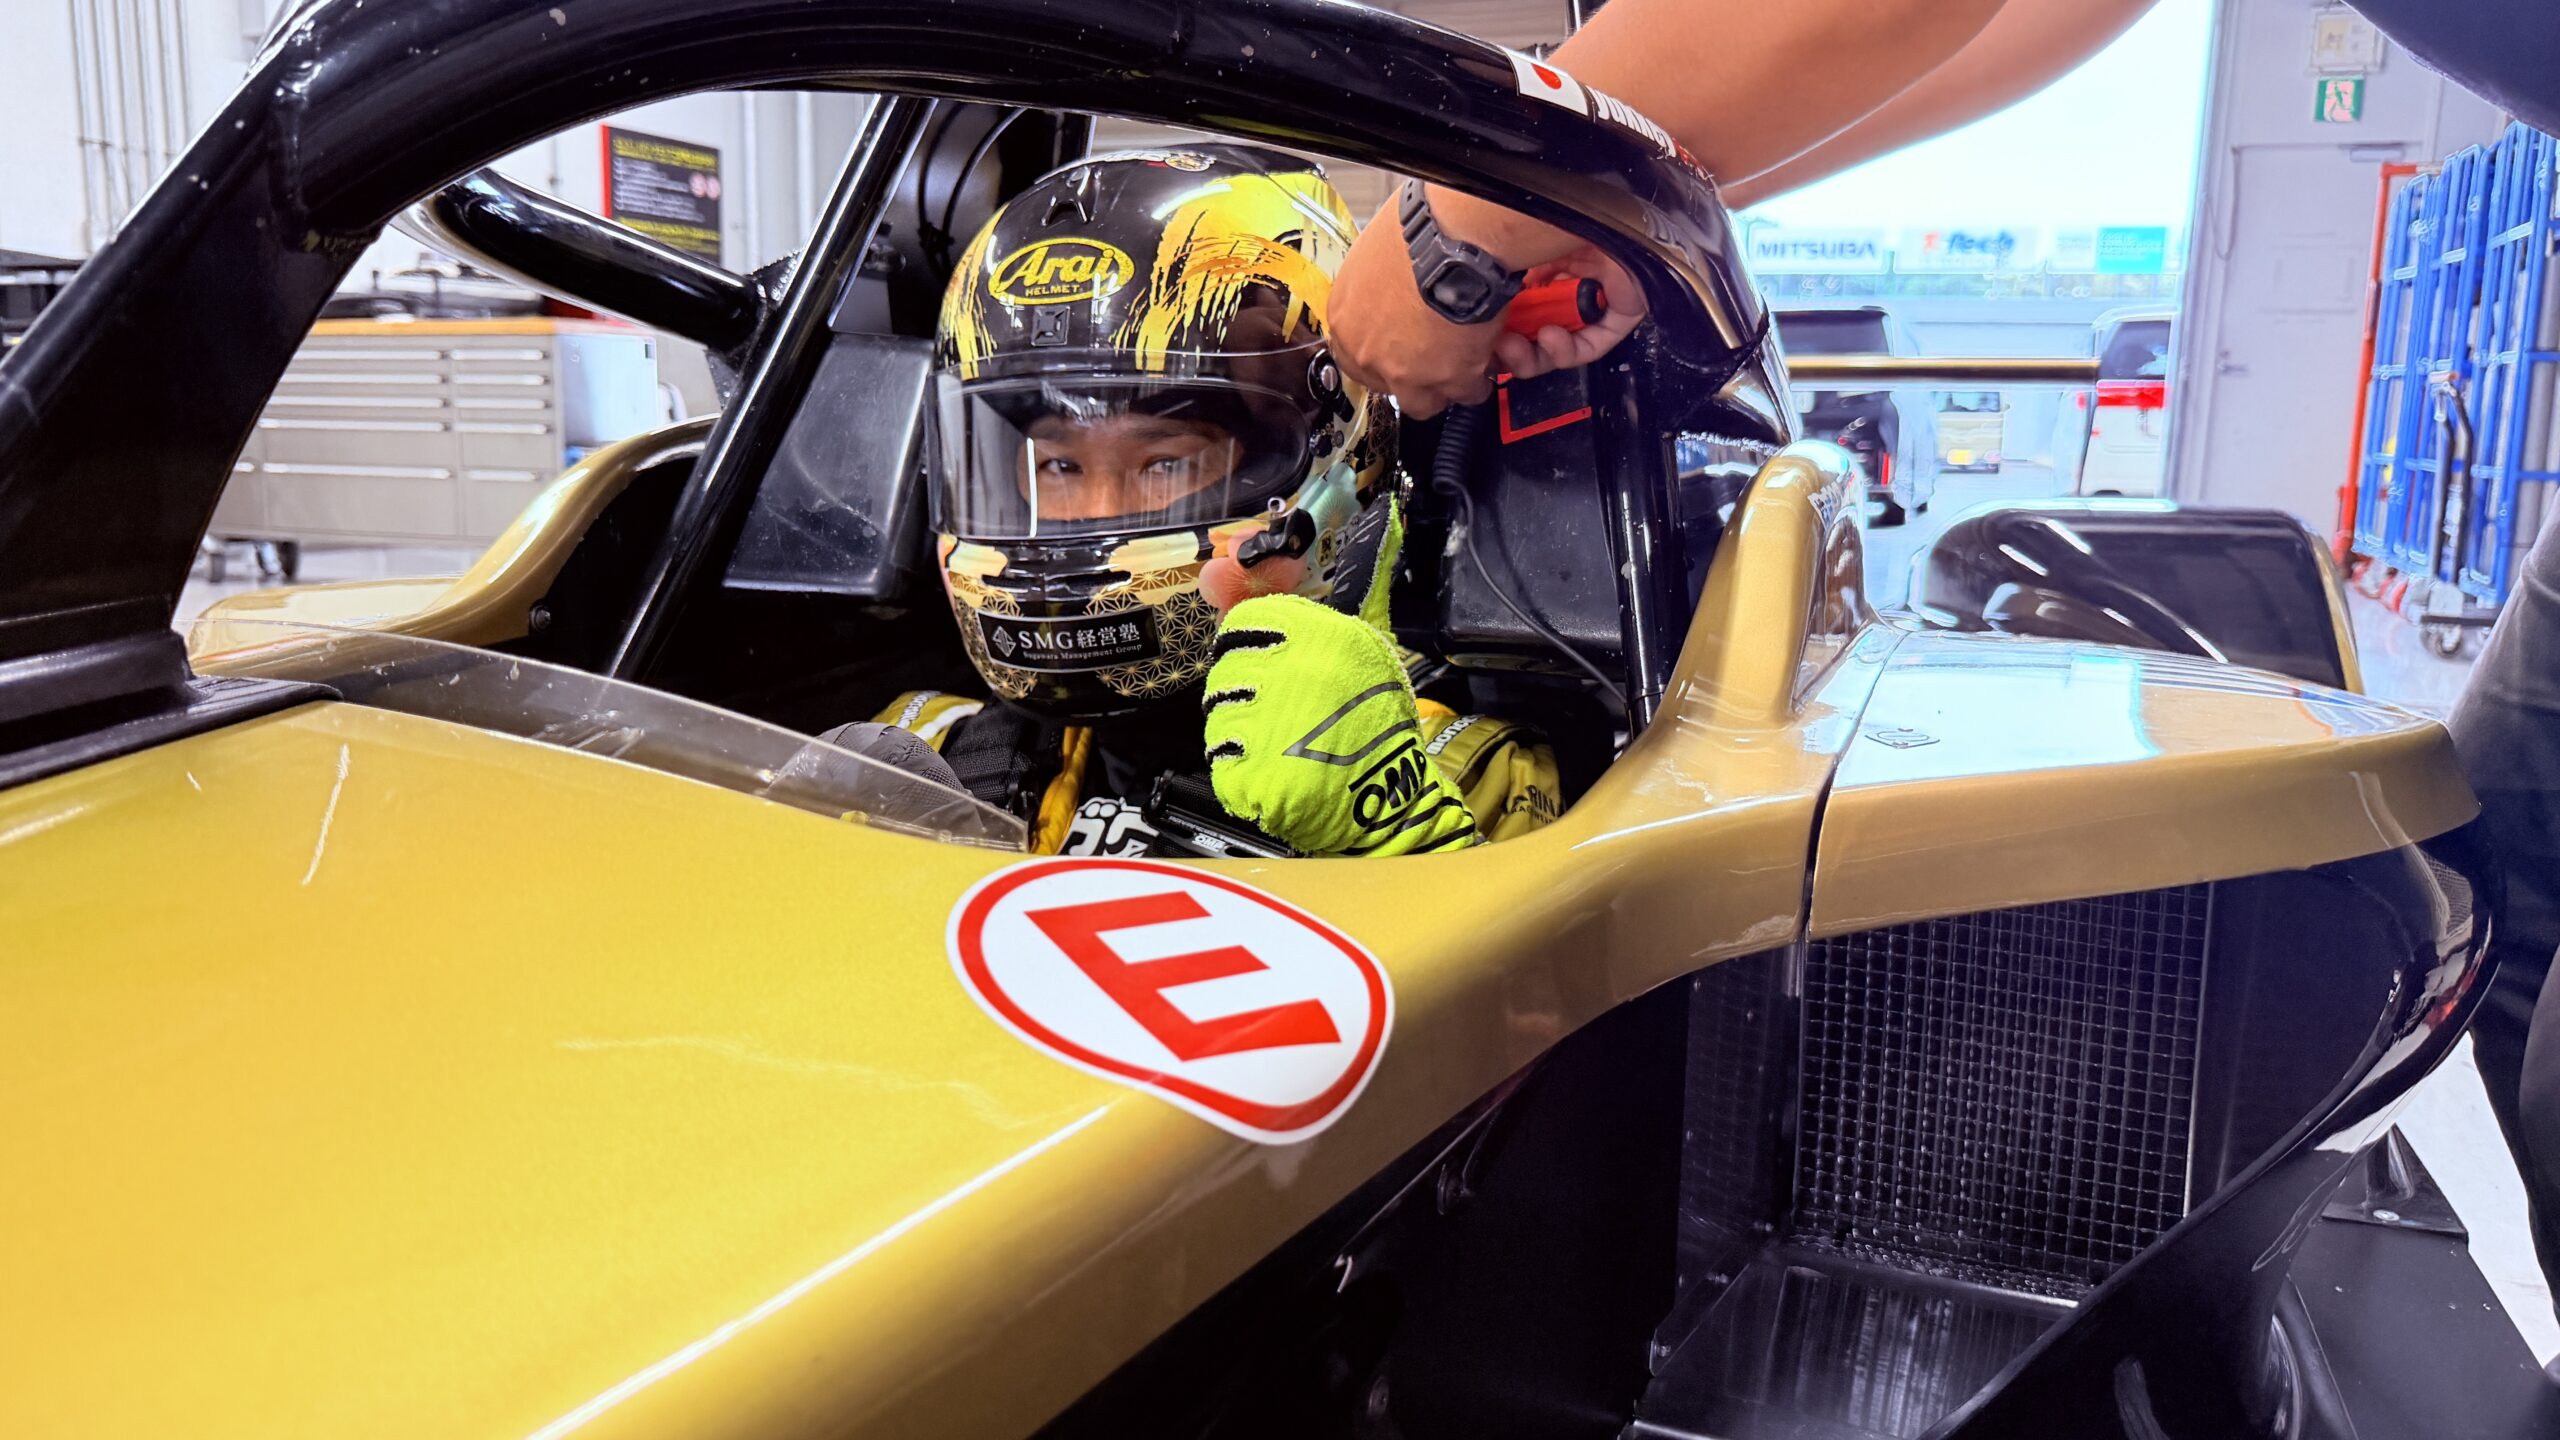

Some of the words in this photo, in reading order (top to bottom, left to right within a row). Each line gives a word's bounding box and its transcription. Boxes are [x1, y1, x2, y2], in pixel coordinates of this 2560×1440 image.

[1757, 242, 1876, 259] MITSUBA
[995, 246, 1116, 292] Arai
[1024, 284, 1081, 297] HELMET
[1115, 643, 1143, 654] Group
[1352, 748, 1428, 829] OMP
[1194, 833, 1226, 852] OMP
[1023, 890, 1342, 1063] E
